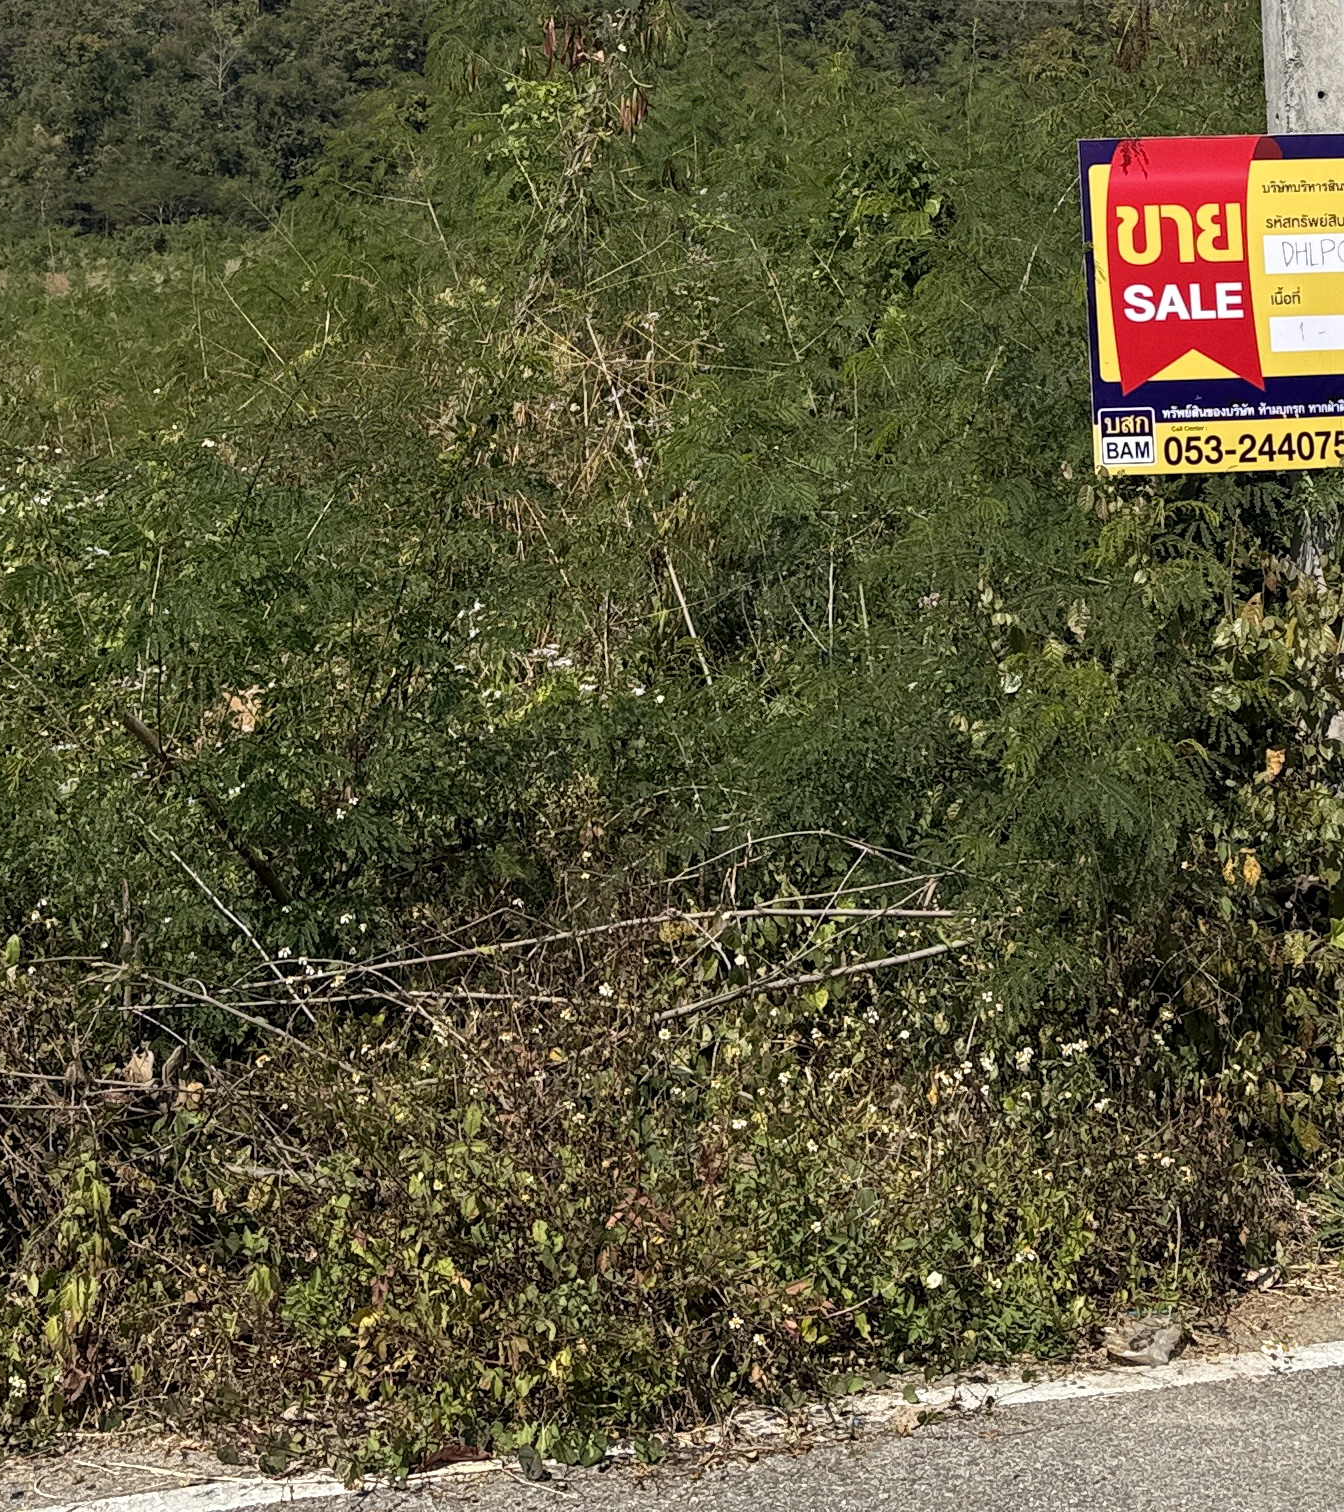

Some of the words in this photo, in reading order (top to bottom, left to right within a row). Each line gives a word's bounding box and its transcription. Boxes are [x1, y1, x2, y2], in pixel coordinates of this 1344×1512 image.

[1115, 202, 1245, 265] ขาย
[1123, 281, 1245, 322] SALE
[1270, 286, 1302, 306] เนื้อที่
[1104, 415, 1150, 434] บสก
[1106, 440, 1151, 460] BAM
